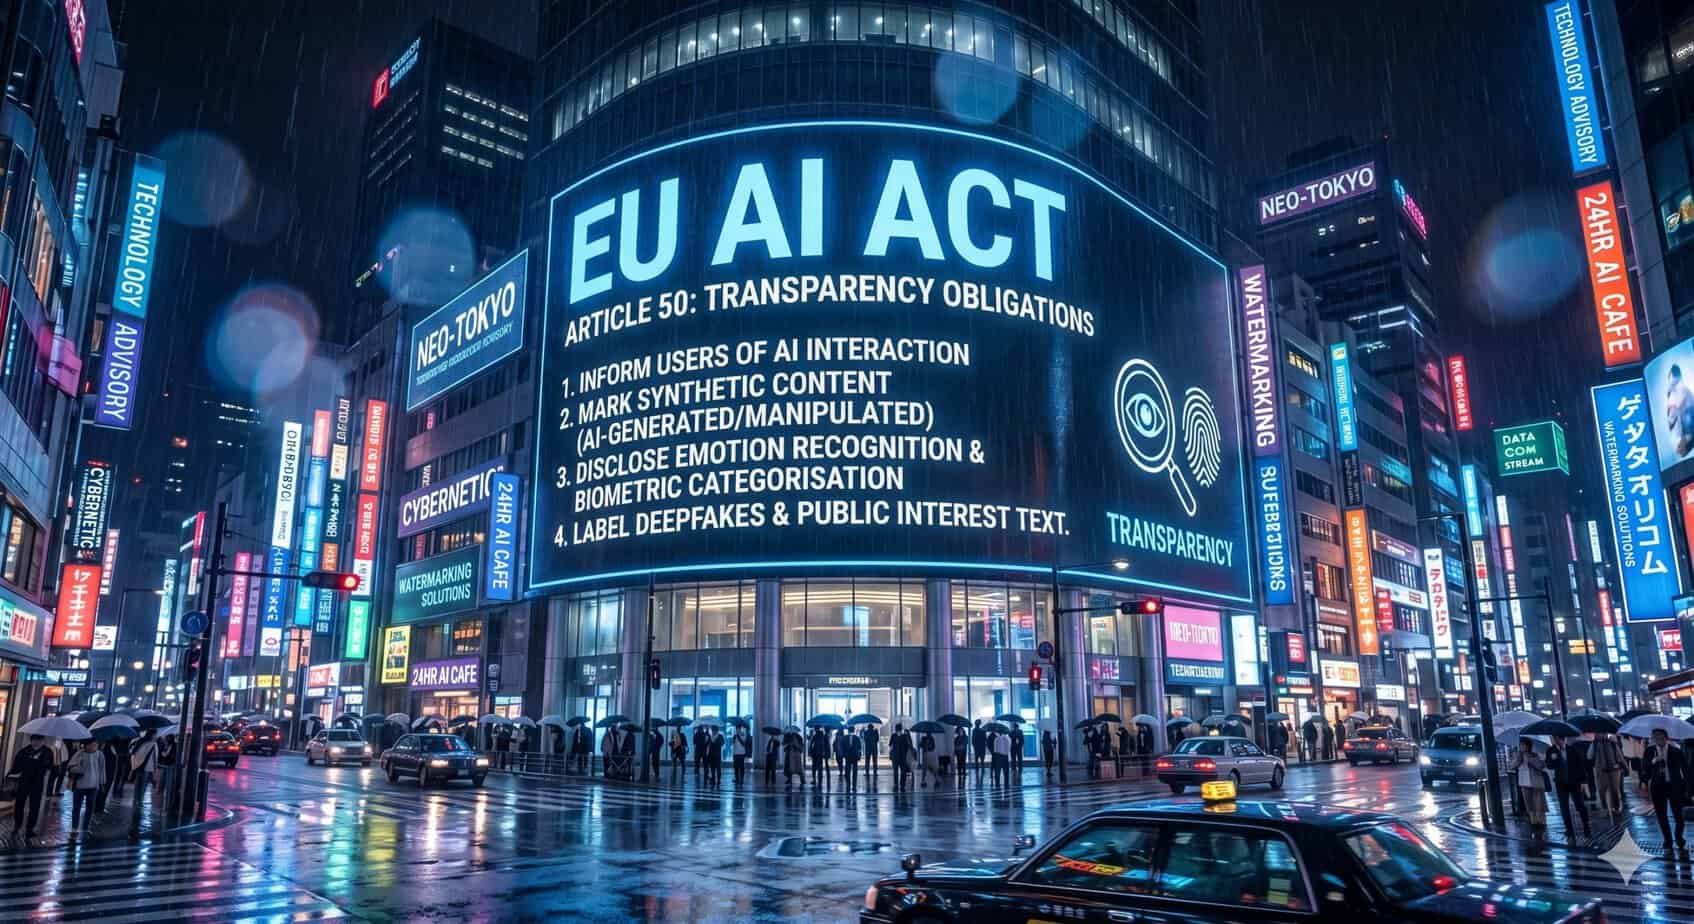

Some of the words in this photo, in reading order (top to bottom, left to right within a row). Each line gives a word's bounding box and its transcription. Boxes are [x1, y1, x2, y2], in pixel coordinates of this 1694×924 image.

[1554, 2, 1584, 91] TECHNOLOGY
[1570, 95, 1598, 163] ADVISORY
[1262, 167, 1374, 219] NEO-TOKYO
[120, 182, 159, 308] TECHNOLOGY
[569, 177, 679, 304] EU
[711, 157, 823, 266] AI
[863, 159, 1066, 281] ACT
[1584, 193, 1615, 253] 24HR
[1595, 261, 1622, 284] AI
[416, 281, 517, 372] NEO-TOKYO
[564, 296, 653, 348] ARTICLE
[658, 289, 697, 320] 50:
[703, 274, 935, 312] TRANSPARENCY
[943, 280, 1095, 337] OBLIGATIONS
[1602, 293, 1633, 354] CAFE
[103, 322, 138, 421] ADVISORY
[562, 377, 575, 400] 1.
[579, 356, 651, 394] INFORM
[657, 344, 729, 376] USERS
[736, 340, 768, 366] OF
[773, 338, 800, 363] AI
[806, 337, 970, 366] INTERACTION
[1244, 273, 1275, 447] WATERMARKING
[559, 408, 575, 430] 2.
[578, 391, 633, 425] MARK
[637, 373, 766, 411] SYNTHETIC
[772, 371, 892, 396] CONTENT
[576, 401, 934, 457] (AI-GENERATED/MANIPULATED)
[1502, 432, 1536, 446] DATA
[1504, 445, 1537, 458] COM
[556, 466, 571, 489] 3.
[576, 446, 670, 485] DISCLOSE
[675, 437, 785, 474] EMOTION
[793, 434, 963, 463] RECOGNITION
[968, 439, 985, 465] &
[575, 475, 682, 513] BIOMETRIC
[688, 464, 904, 498] CATEGORISATION
[1504, 457, 1544, 471] STREAM
[79, 467, 105, 549] CYBERNETIC
[402, 464, 504, 527] CYBERNETIC
[495, 481, 513, 524] 24HR
[554, 524, 568, 548] 4.
[573, 514, 630, 545] LABEL
[636, 501, 766, 537] DEEPFAKES
[772, 500, 790, 526] &
[798, 499, 890, 526] PUBLIC
[897, 501, 1011, 530] INTEREST
[1015, 507, 1071, 536] TEXT.
[495, 527, 509, 545] AI
[1107, 511, 1233, 568] TRANSPARENCY
[1616, 504, 1637, 569] SOLUTIONS
[399, 561, 472, 594] WATERMARKING
[421, 583, 471, 607] SOLUTIONS
[492, 549, 510, 590] CAFE
[411, 669, 438, 686] 24HR
[438, 667, 449, 685] AI
[450, 664, 477, 684] CAFE
